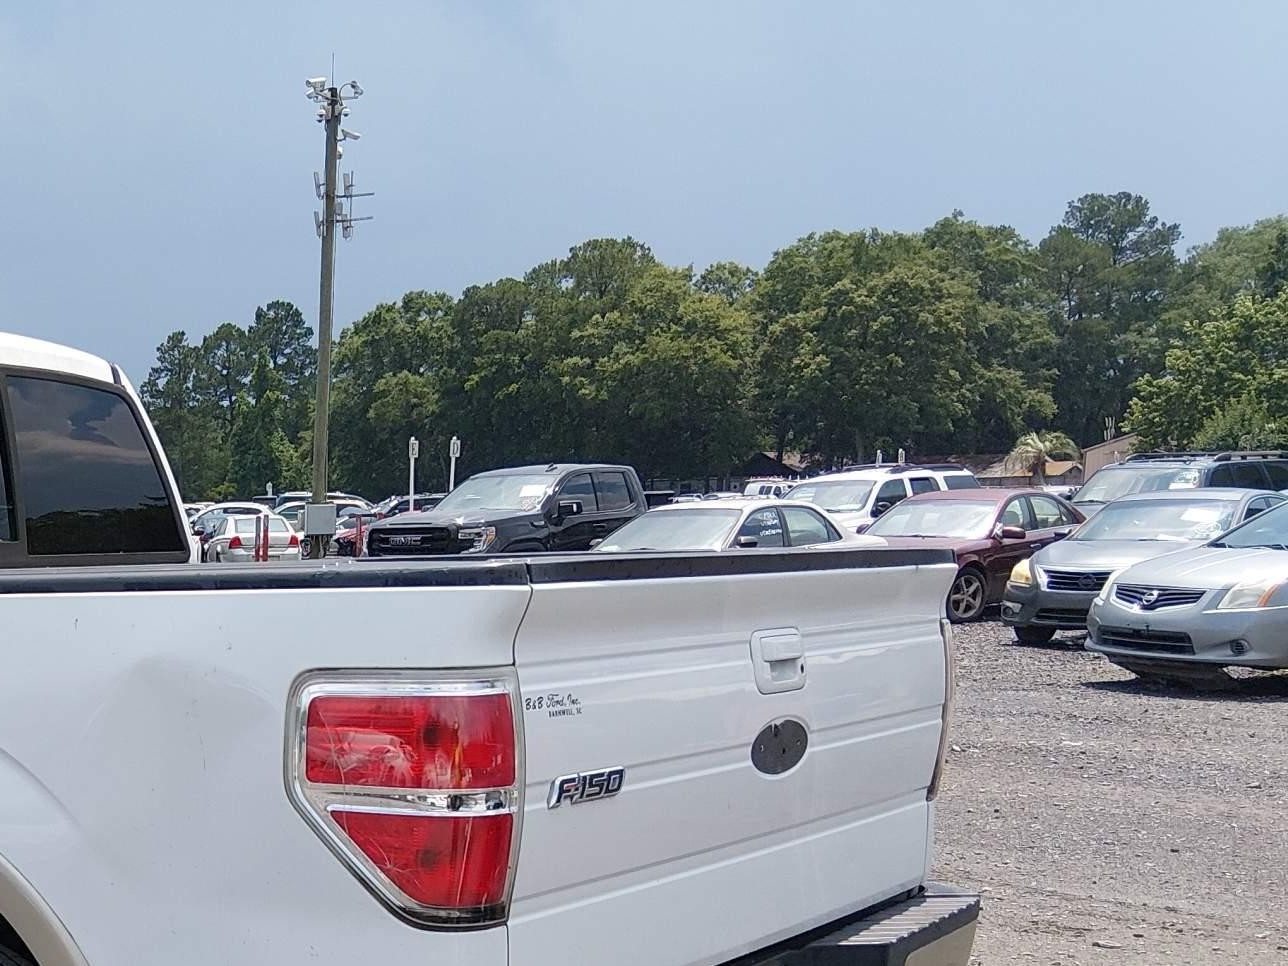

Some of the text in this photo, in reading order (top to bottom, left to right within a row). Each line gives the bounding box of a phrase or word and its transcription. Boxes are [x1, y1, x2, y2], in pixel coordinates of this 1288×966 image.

[452, 441, 459, 456] D
[390, 535, 422, 546] GMC
[525, 696, 544, 711] B&B
[554, 769, 625, 808] F-150
